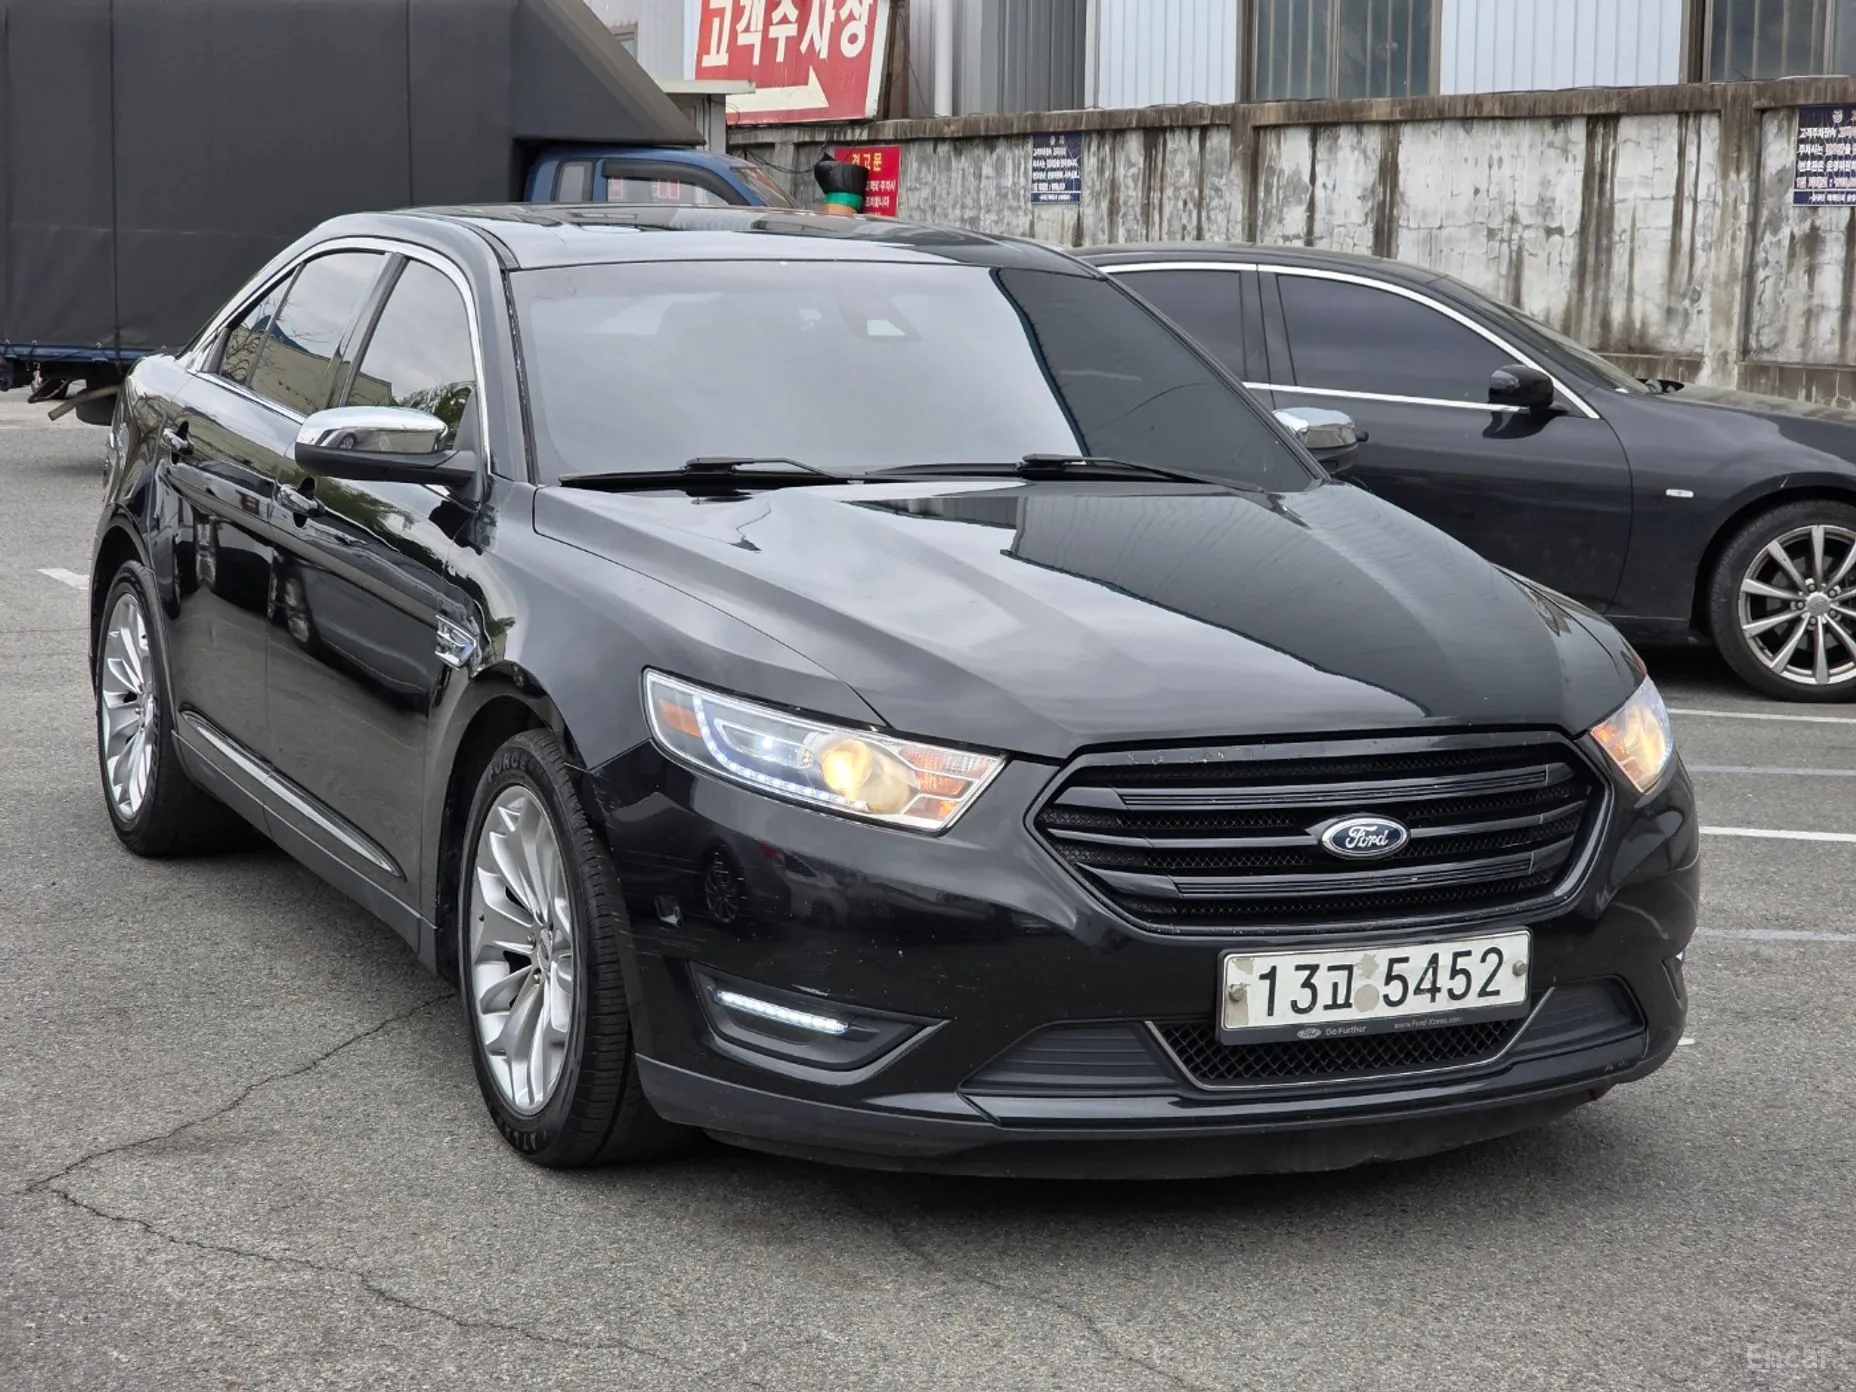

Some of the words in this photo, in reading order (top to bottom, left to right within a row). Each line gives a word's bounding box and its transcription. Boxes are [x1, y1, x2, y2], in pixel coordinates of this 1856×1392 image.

[1345, 826, 1389, 848] Ford
[1258, 963, 1355, 1017] 13고
[1382, 946, 1504, 1008] 5452
